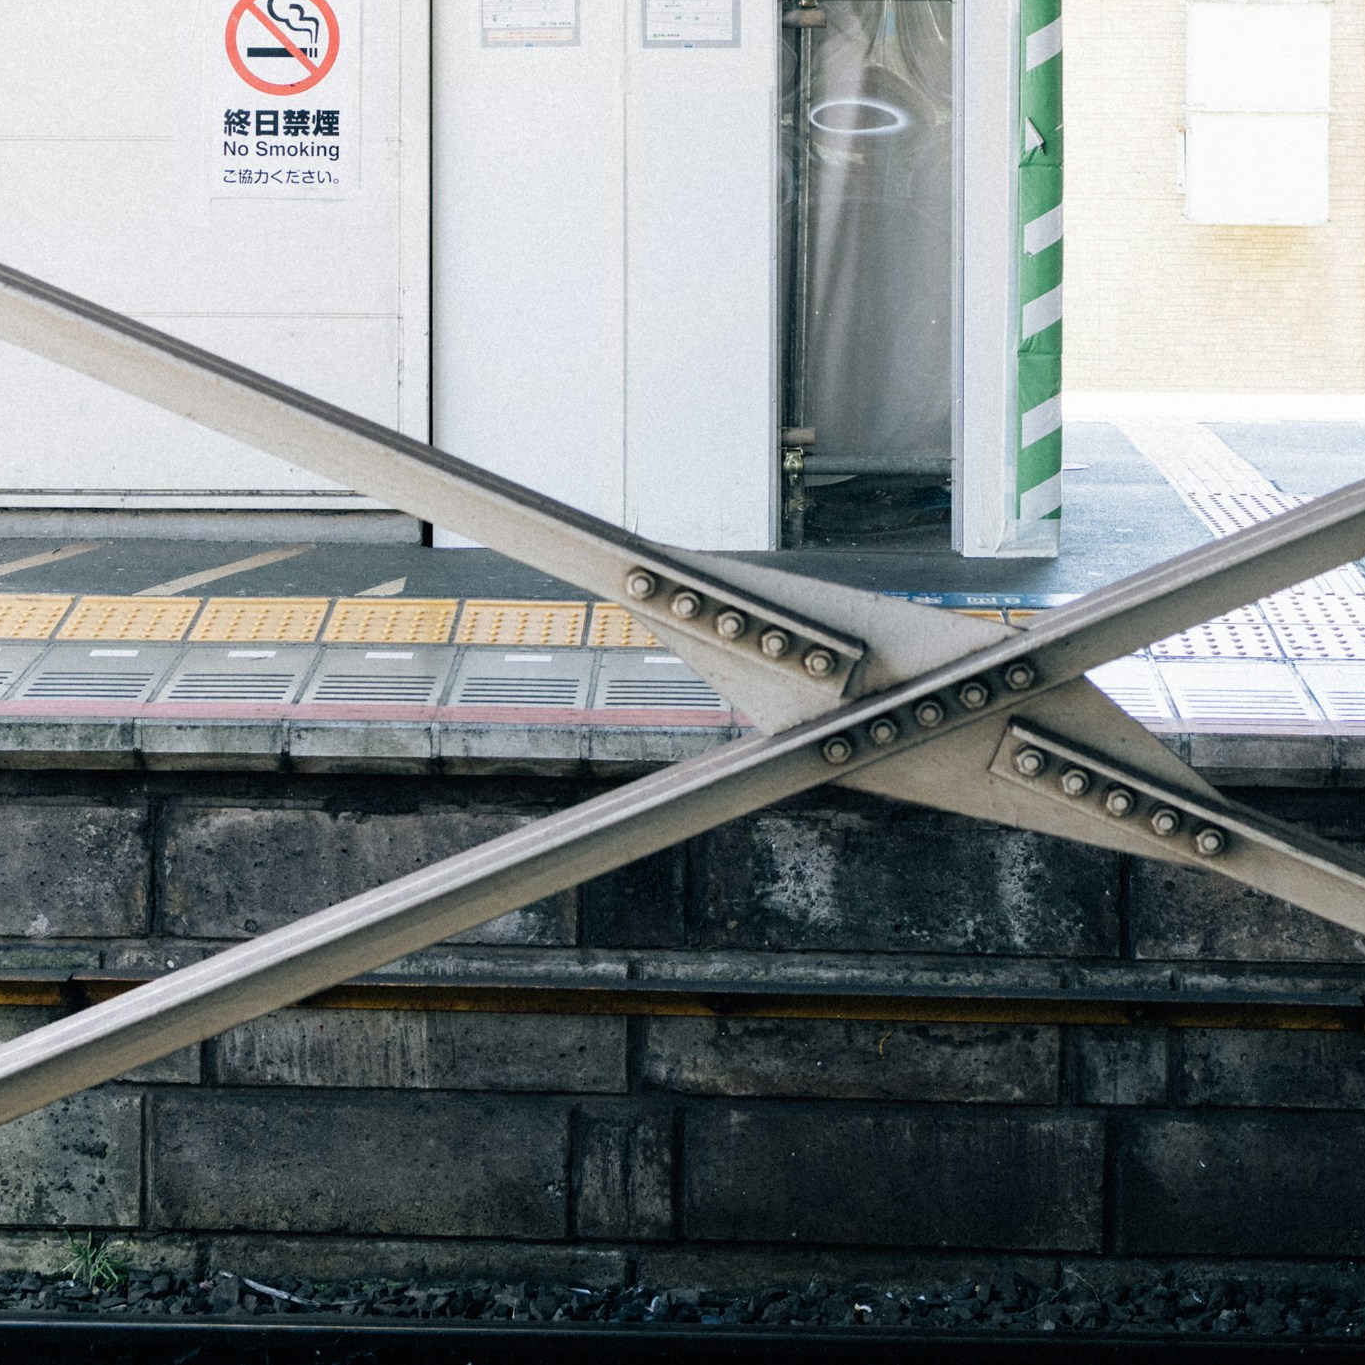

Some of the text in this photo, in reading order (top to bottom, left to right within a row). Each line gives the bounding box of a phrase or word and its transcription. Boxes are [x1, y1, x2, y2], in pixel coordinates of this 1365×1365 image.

[223, 108, 340, 137] 終日禁煙
[223, 141, 340, 161] No Smoking
[223, 168, 340, 185] ご協力ください。
